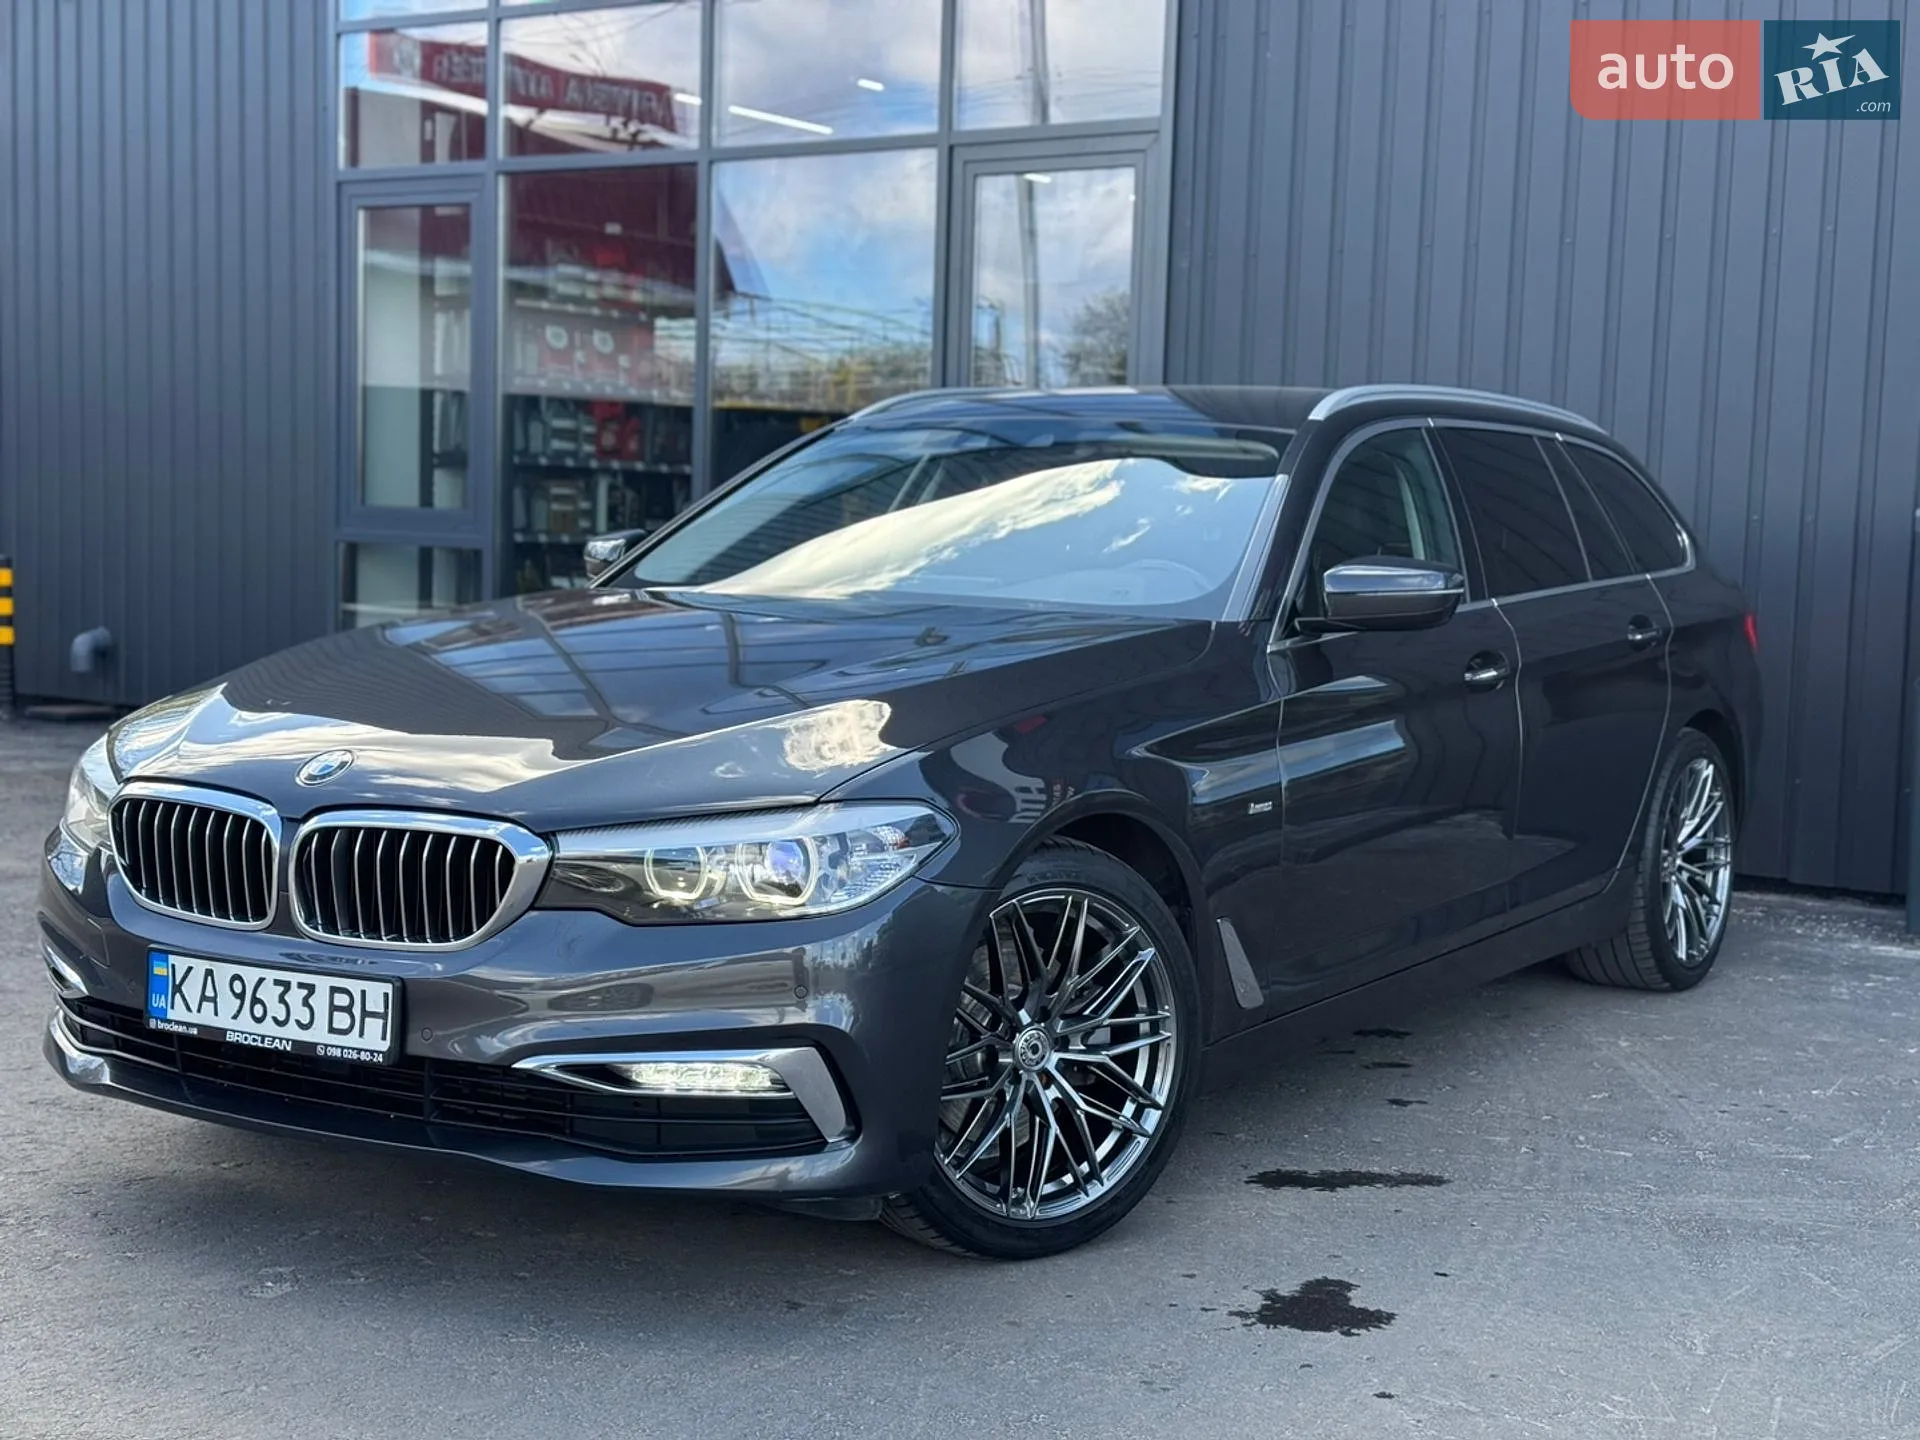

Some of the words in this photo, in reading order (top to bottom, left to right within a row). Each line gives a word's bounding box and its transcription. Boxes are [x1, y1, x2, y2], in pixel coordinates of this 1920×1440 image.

[151, 994, 167, 1009] UA
[170, 963, 219, 1017] KA
[229, 973, 316, 1031] 9633
[327, 985, 389, 1042] BH
[226, 1031, 292, 1051] BROCLEAN
[326, 1047, 341, 1058] 098
